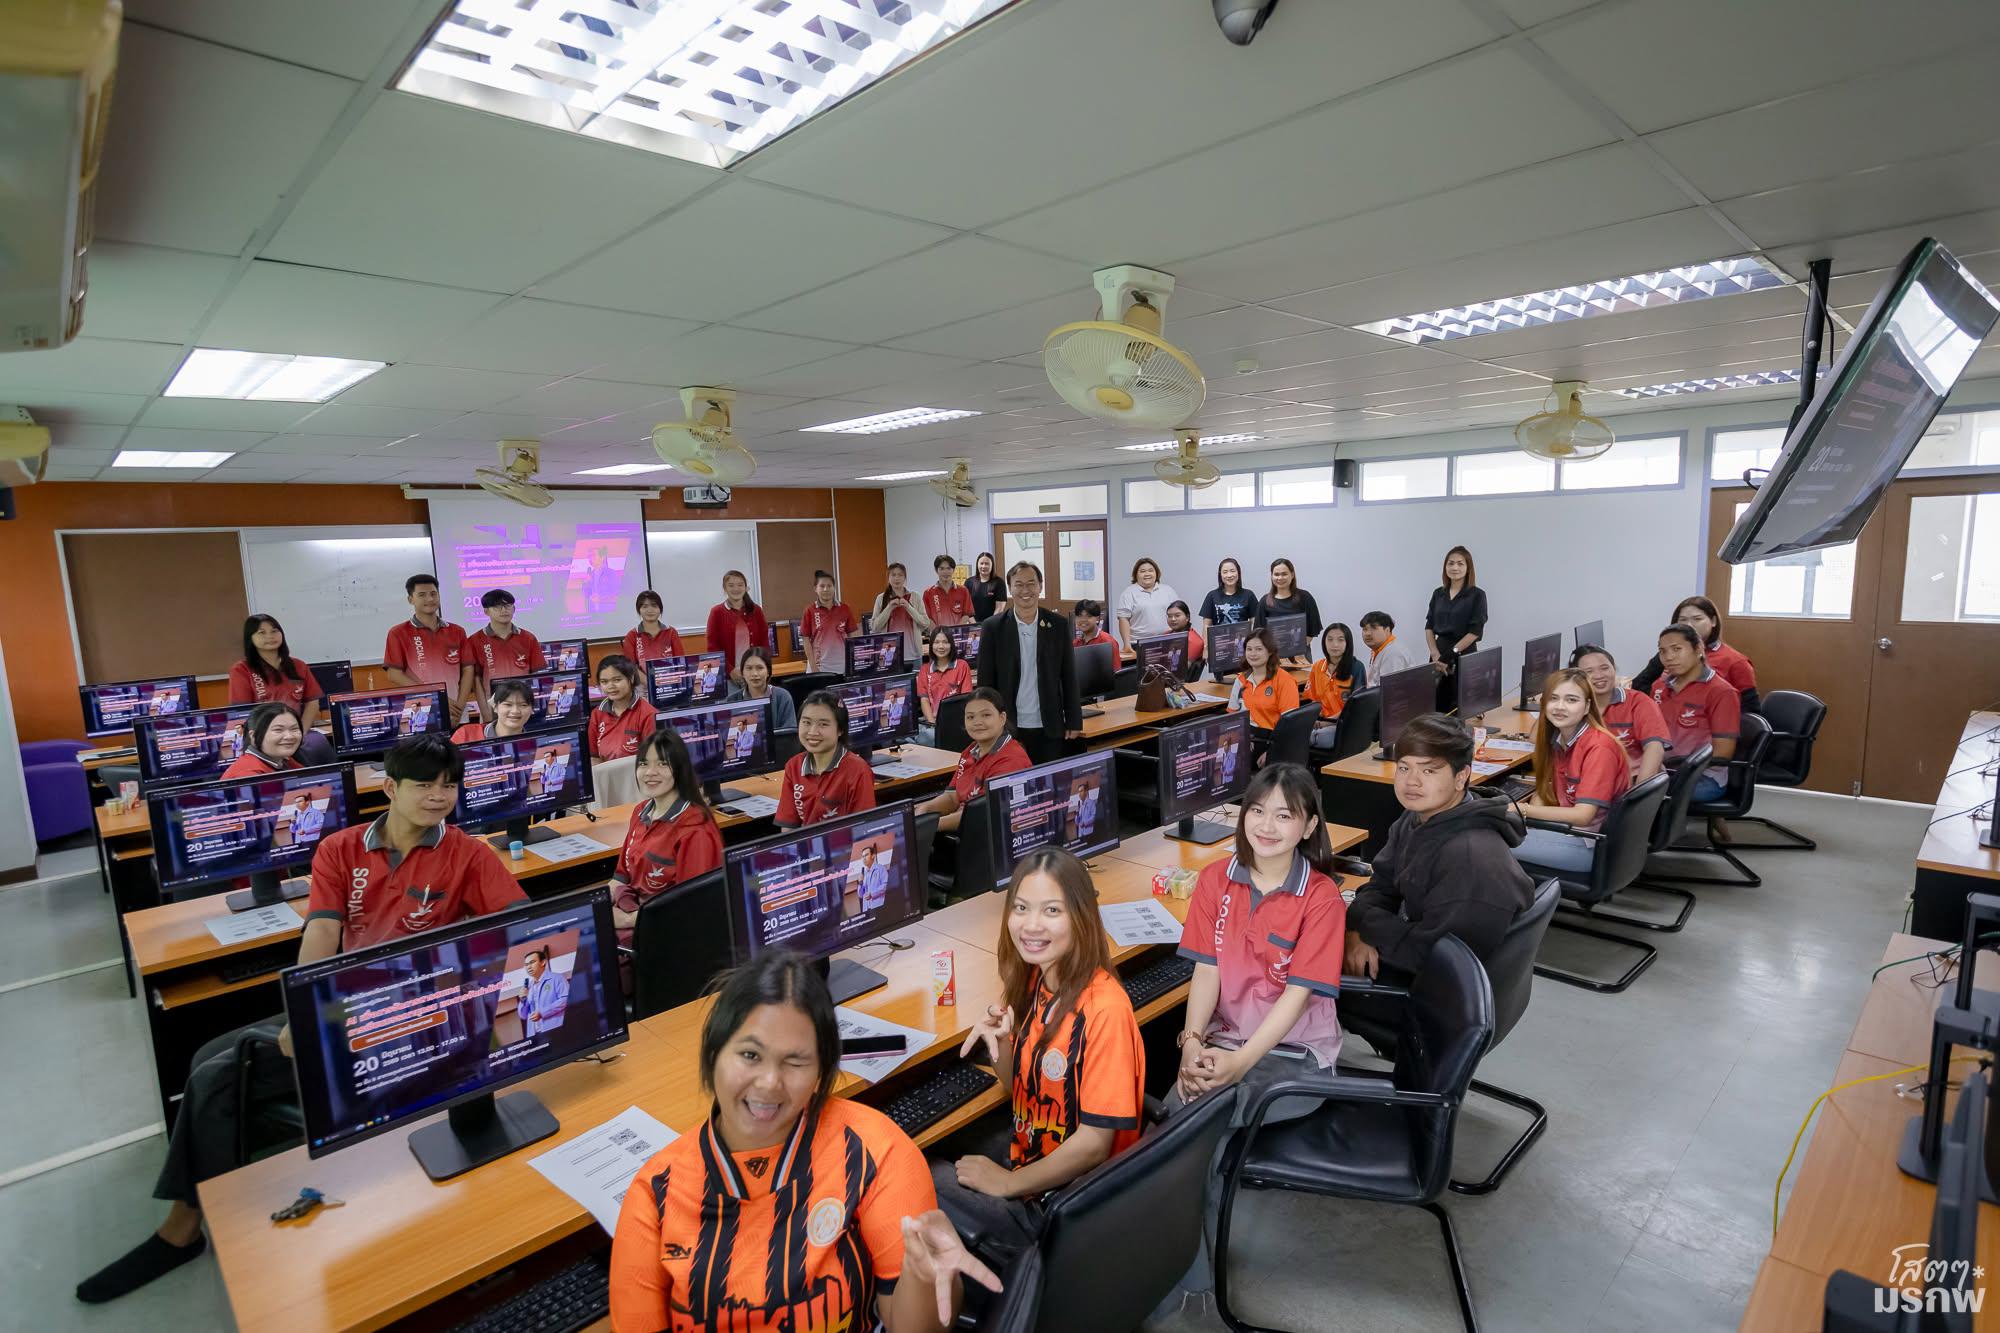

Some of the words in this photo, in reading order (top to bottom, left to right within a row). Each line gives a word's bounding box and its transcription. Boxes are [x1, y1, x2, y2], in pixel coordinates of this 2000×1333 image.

[186, 842, 203, 853] 20
[1012, 836, 1023, 848] 20
[347, 867, 369, 921] SOCIAL
[762, 917, 778, 933] 20
[352, 1056, 380, 1077] 20
